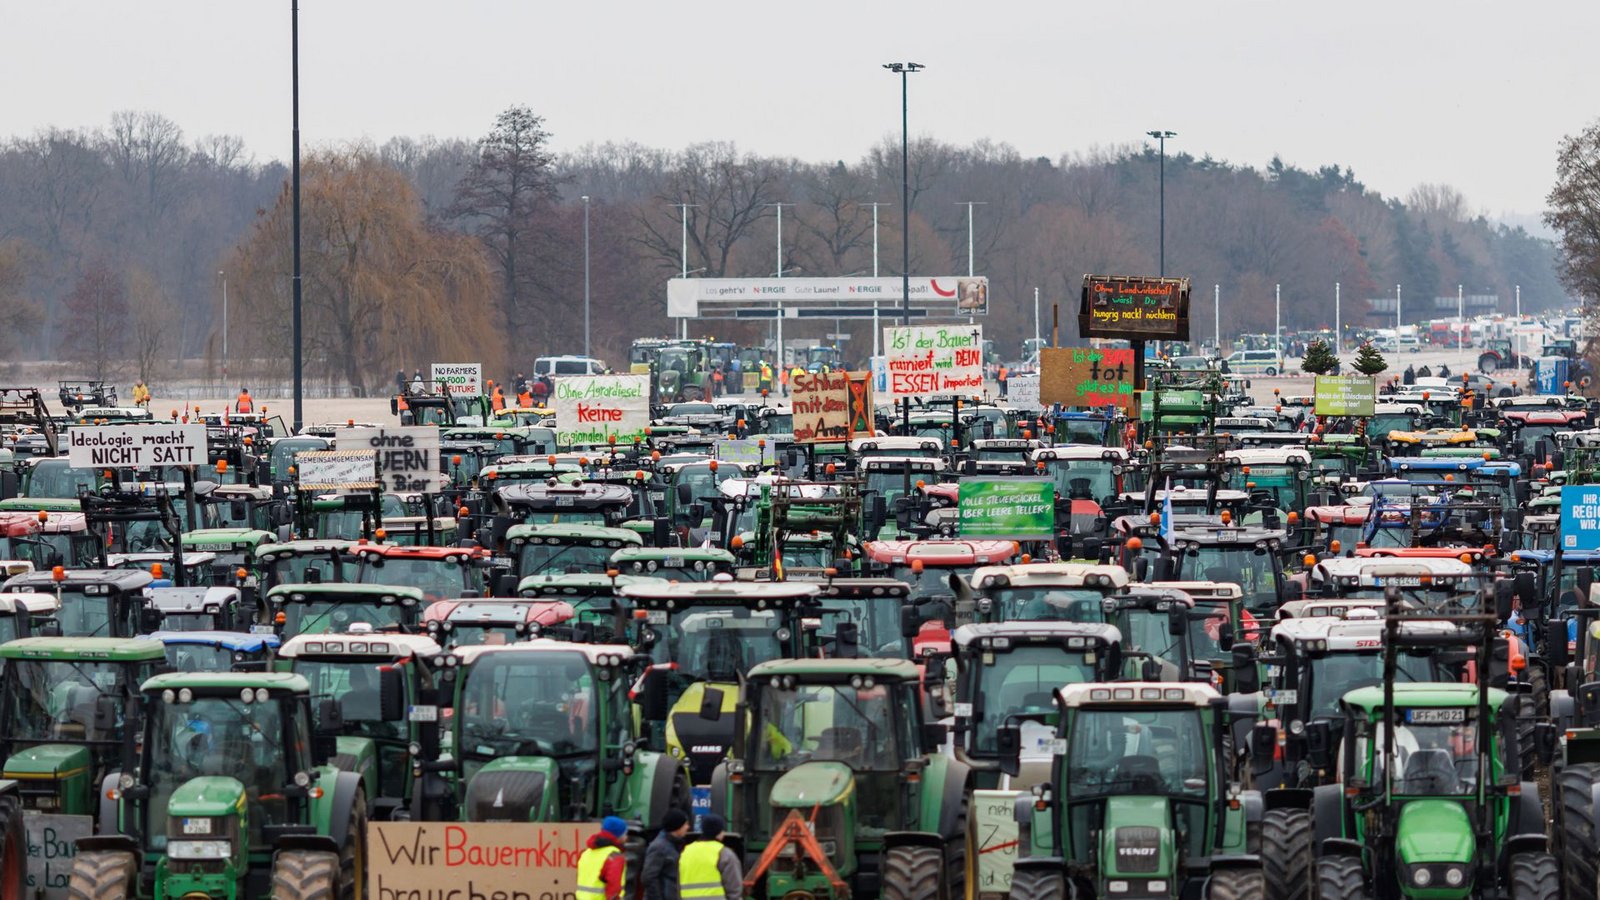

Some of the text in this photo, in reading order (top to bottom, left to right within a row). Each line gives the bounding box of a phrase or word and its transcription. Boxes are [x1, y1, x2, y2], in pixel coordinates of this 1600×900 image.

[813, 286, 840, 294] Laune!
[1145, 296, 1157, 305] Du
[1122, 308, 1142, 320] nackt
[892, 329, 973, 349] Ist der Bauer
[935, 356, 953, 368] wird
[955, 350, 980, 367] DEIN
[447, 367, 477, 375] FARMERS
[1089, 360, 1129, 380] tot
[447, 376, 466, 384] FOOD
[892, 371, 939, 394] ESSEN
[448, 385, 476, 393] FUTURE
[71, 430, 185, 448] Ideologie macht
[370, 429, 414, 448] ohne
[92, 446, 195, 465] NICHT SATT
[299, 454, 375, 464] GEMEINSAM GEMEINSAM
[381, 449, 429, 472] UERN
[392, 473, 431, 492] Bier
[962, 496, 984, 506] VOLLE
[1583, 494, 1598, 505] IHR
[962, 504, 1051, 519] ABER LEERE TELLER?
[1572, 505, 1600, 519] REGI
[1580, 519, 1597, 530] WIR
[1356, 640, 1383, 648] STEY
[1412, 711, 1430, 720] UFF
[692, 745, 722, 753] CLAAS
[988, 801, 1012, 816] neh
[44, 827, 79, 859] Bau
[378, 825, 586, 868] Wir Bauernkind
[1119, 847, 1157, 856] FENDT
[45, 861, 70, 888] La
